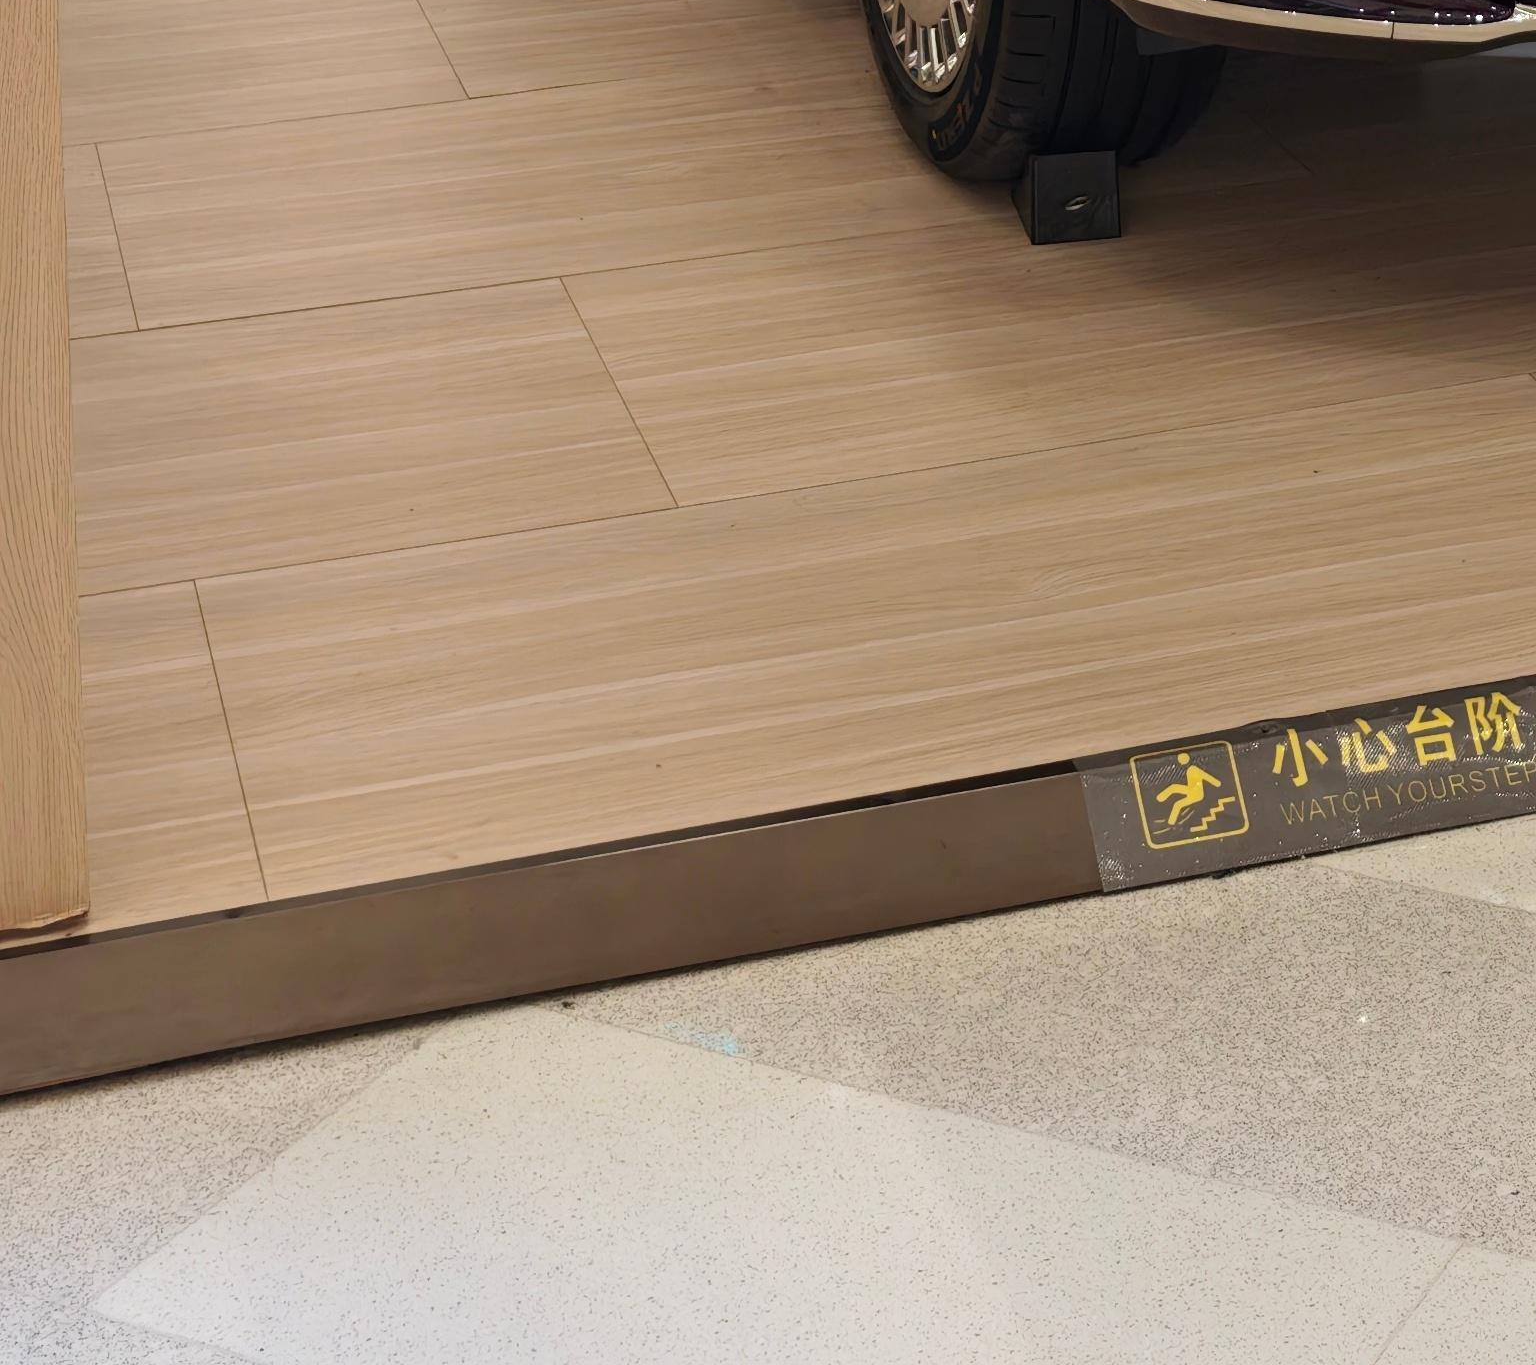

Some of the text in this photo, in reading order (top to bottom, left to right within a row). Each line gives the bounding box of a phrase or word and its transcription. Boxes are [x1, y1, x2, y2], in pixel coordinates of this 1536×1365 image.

[1271, 691, 1522, 788] 小心台阶
[1280, 787, 1383, 825] WATCH
